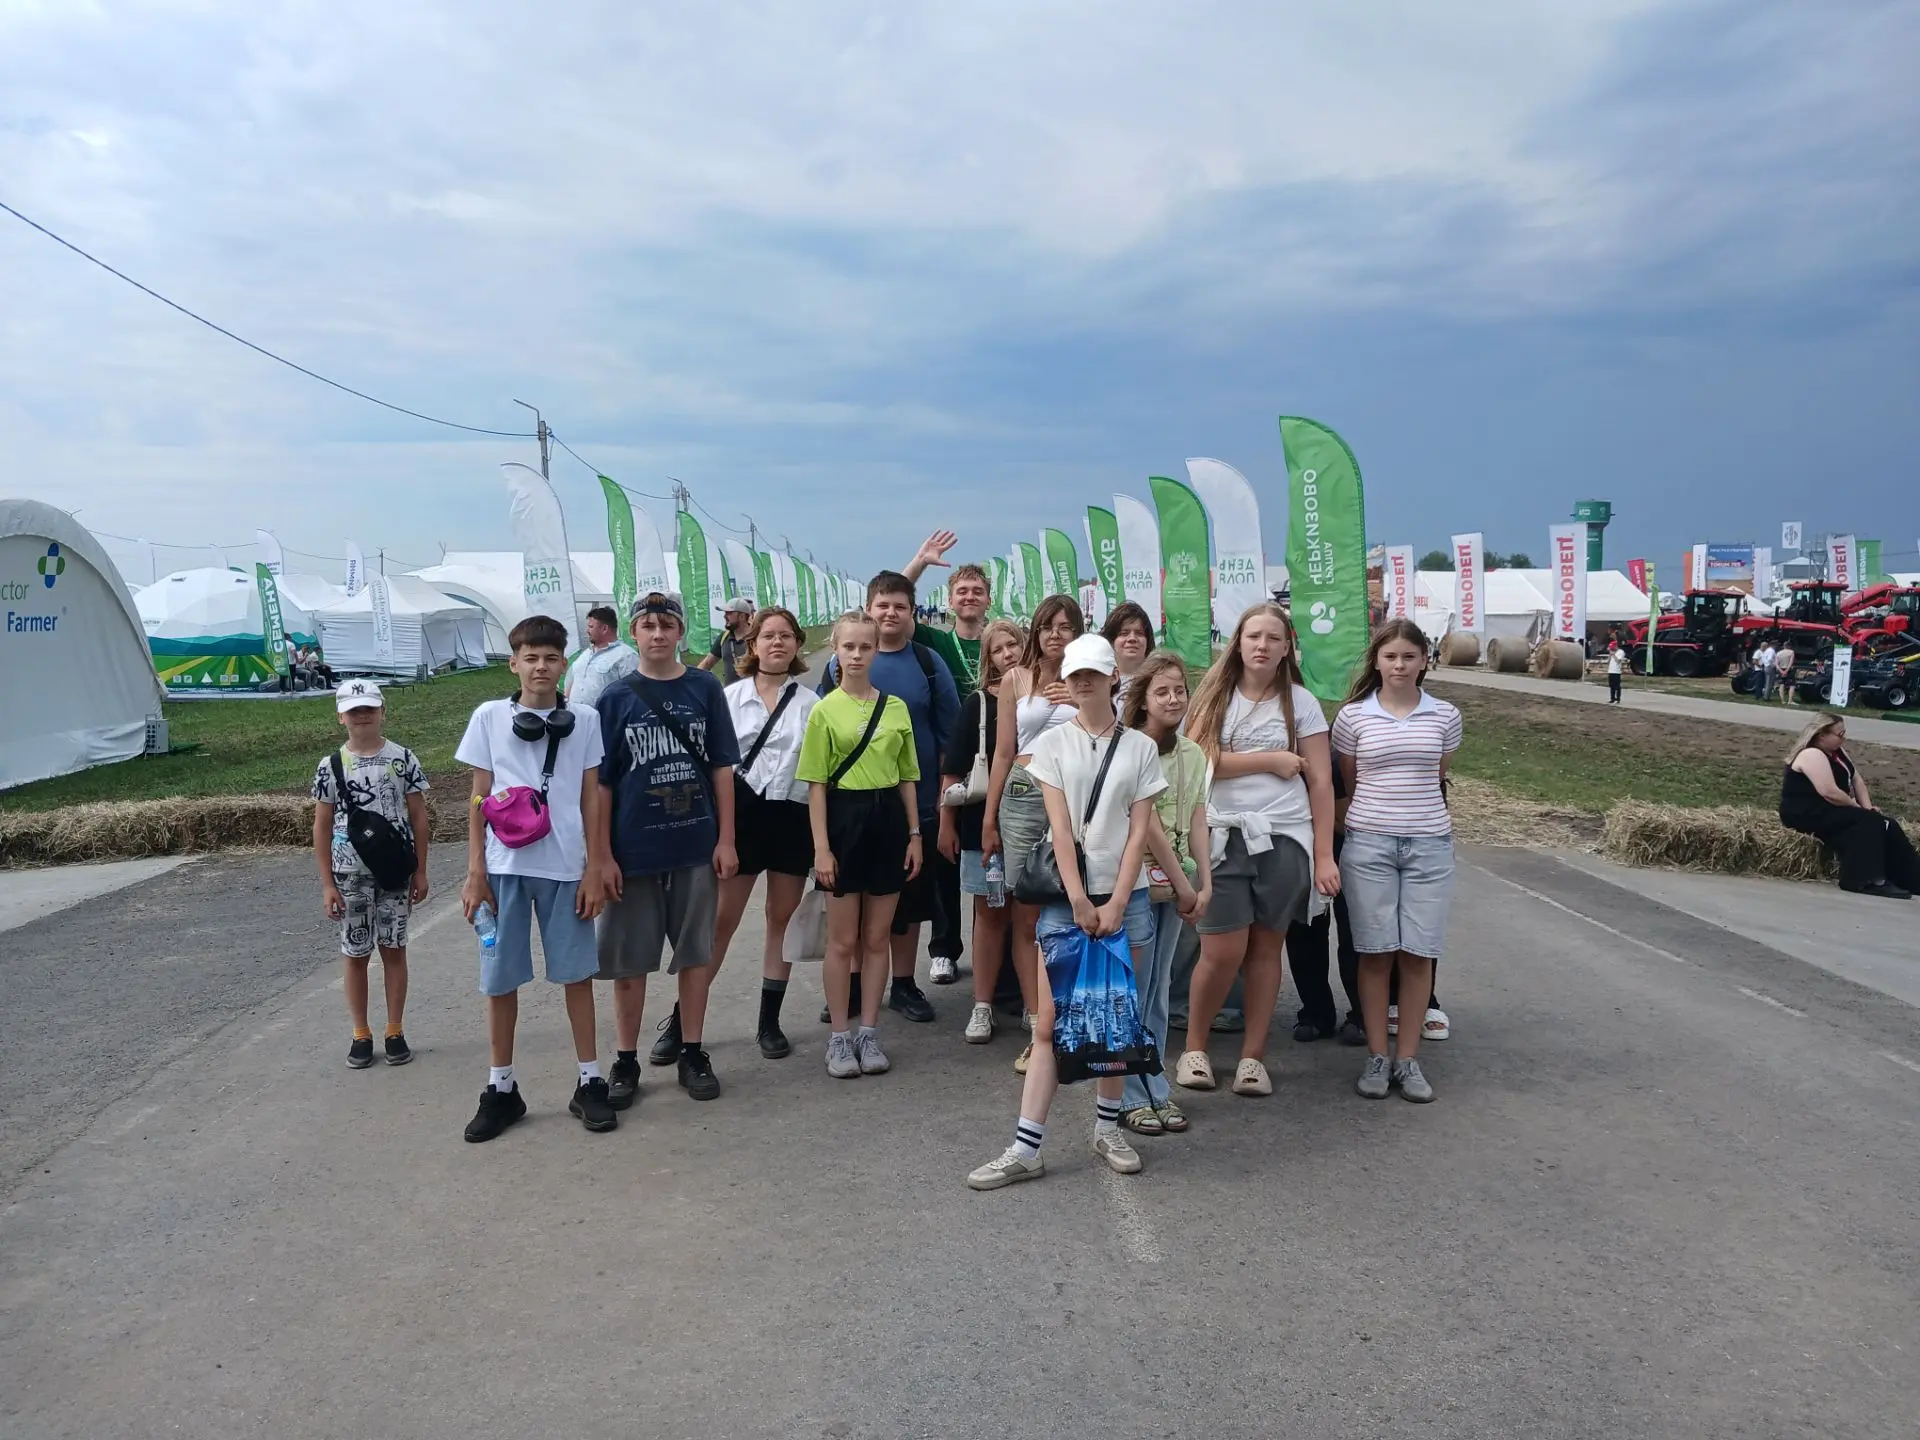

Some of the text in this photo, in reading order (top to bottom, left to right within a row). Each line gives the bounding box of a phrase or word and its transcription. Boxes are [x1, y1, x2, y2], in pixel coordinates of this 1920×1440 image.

[0, 580, 30, 600] ctor
[7, 611, 58, 632] Farmer
[664, 761, 685, 773] PATH
[650, 770, 696, 785] RESISTANC
